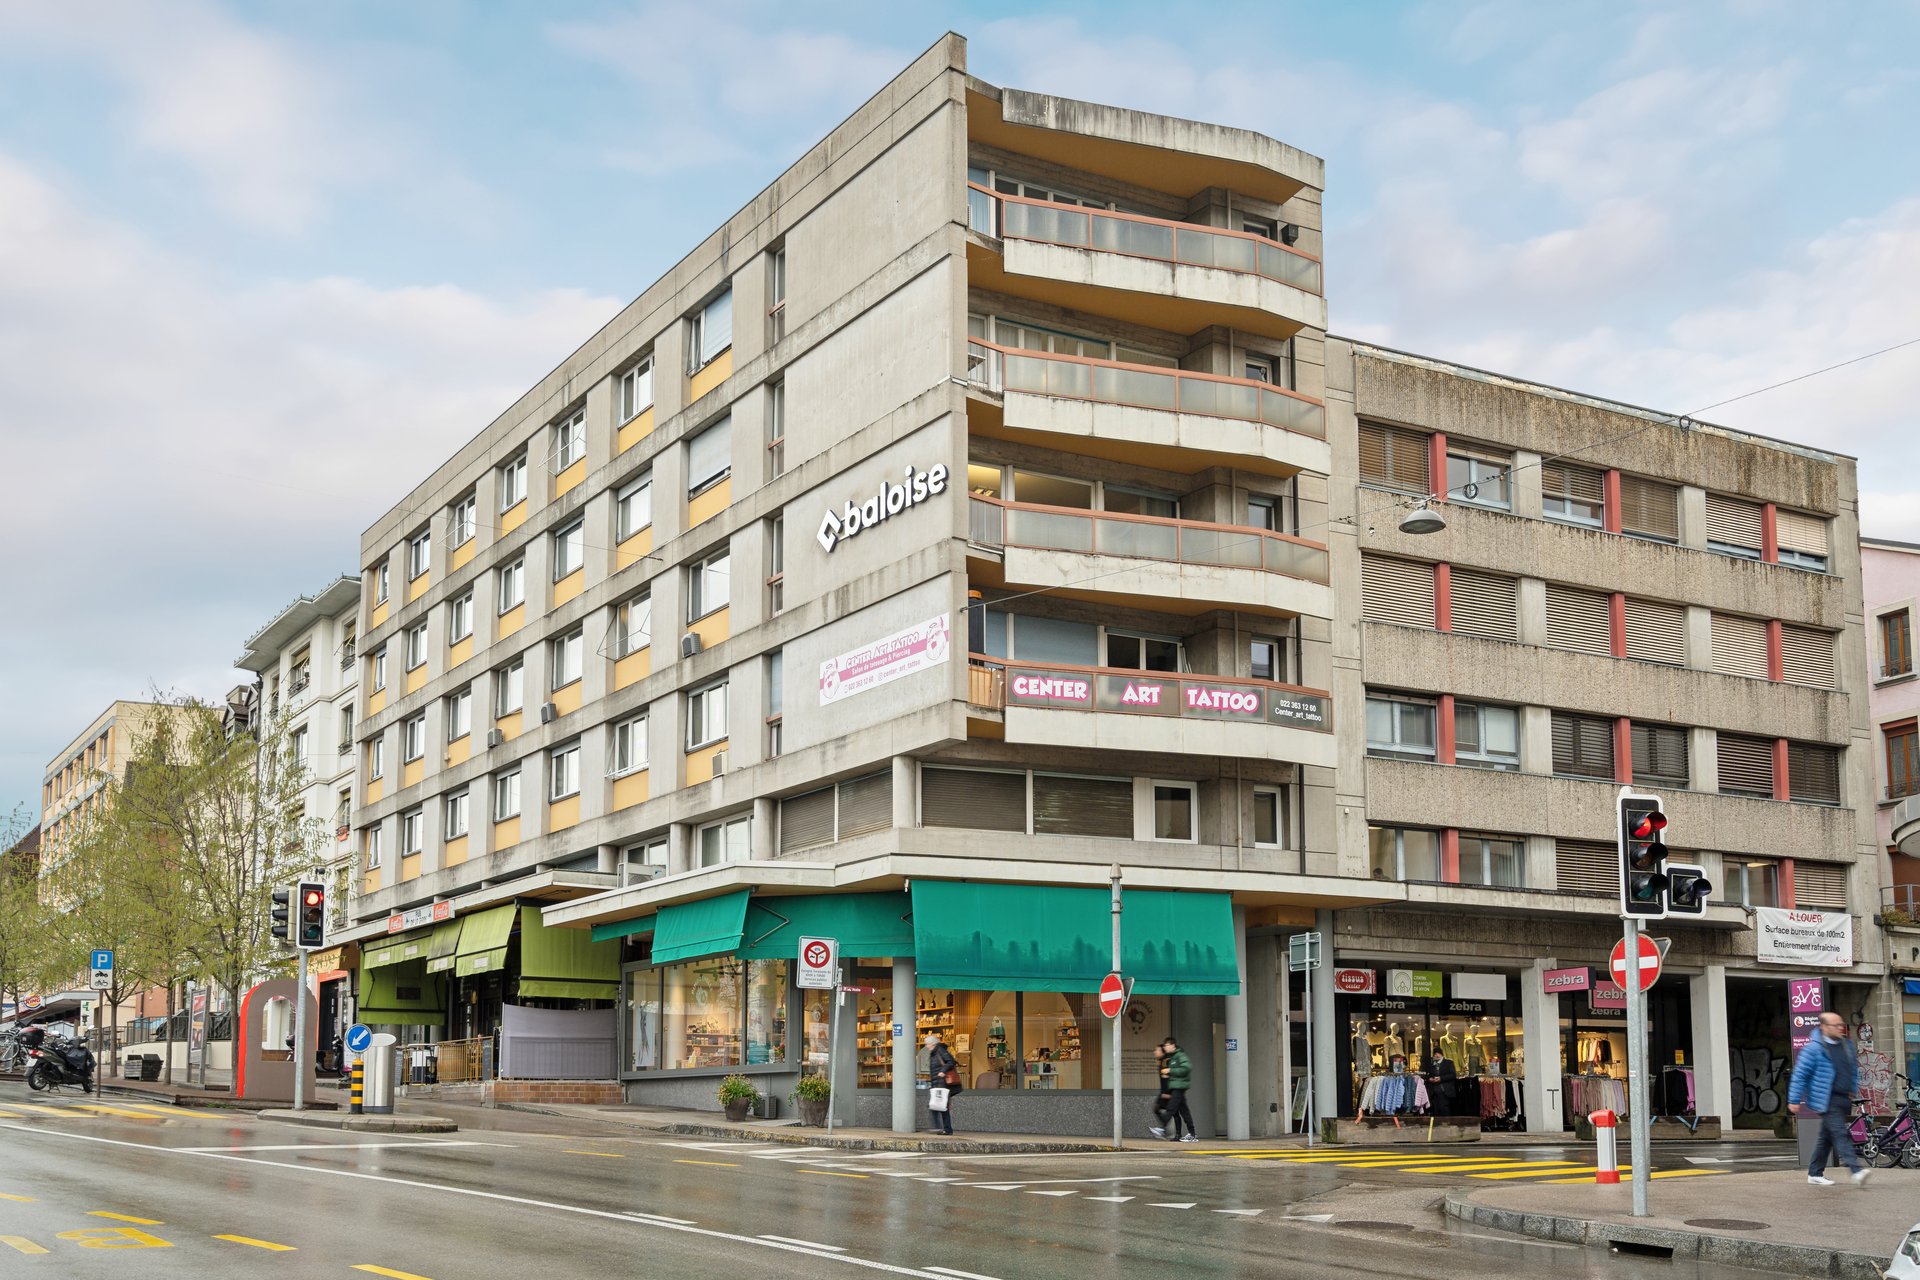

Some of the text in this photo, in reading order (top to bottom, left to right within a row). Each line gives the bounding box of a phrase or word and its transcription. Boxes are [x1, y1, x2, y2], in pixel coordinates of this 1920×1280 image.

[844, 463, 948, 537] baloise
[846, 632, 919, 669] CENTER ART TATTOO
[1013, 677, 1258, 712] CENTER ART TATTOO
[1280, 699, 1290, 708] 022
[1302, 703, 1309, 711] 12
[1796, 913, 1823, 923] LOUER
[1765, 925, 1789, 935] Surface
[1791, 927, 1815, 937] bureaux
[97, 953, 108, 968] P
[1341, 974, 1364, 983] tissus
[1548, 974, 1584, 986] zebra
[1596, 988, 1627, 999] zebr
[1371, 999, 1406, 1009] zebra
[1449, 1001, 1482, 1012] zebra
